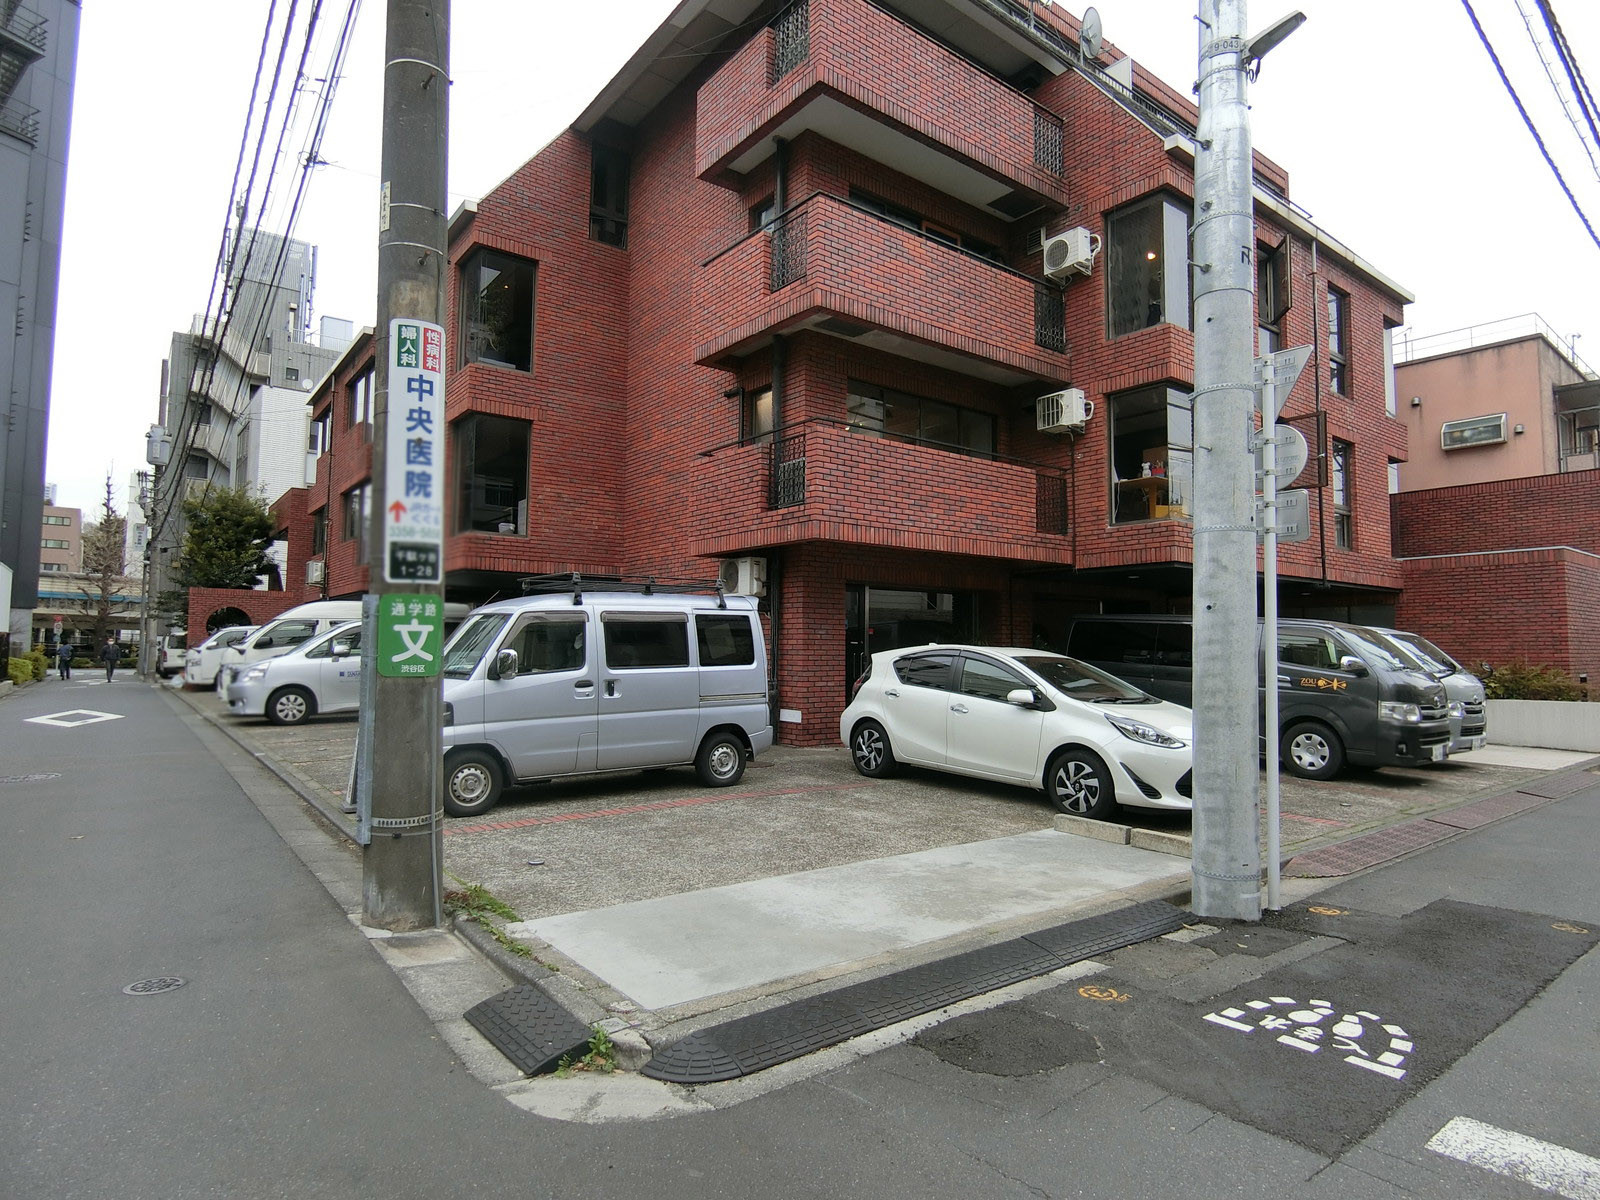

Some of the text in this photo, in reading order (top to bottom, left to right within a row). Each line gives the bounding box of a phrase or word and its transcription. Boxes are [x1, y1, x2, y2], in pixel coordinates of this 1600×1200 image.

[400, 326, 417, 367] 婦人科
[426, 330, 440, 371] 性病科
[405, 374, 434, 499] 中央医院
[401, 565, 433, 577] 1-28
[391, 602, 436, 617] 通学路
[391, 618, 434, 662] 文
[401, 664, 426, 673] 渋谷区
